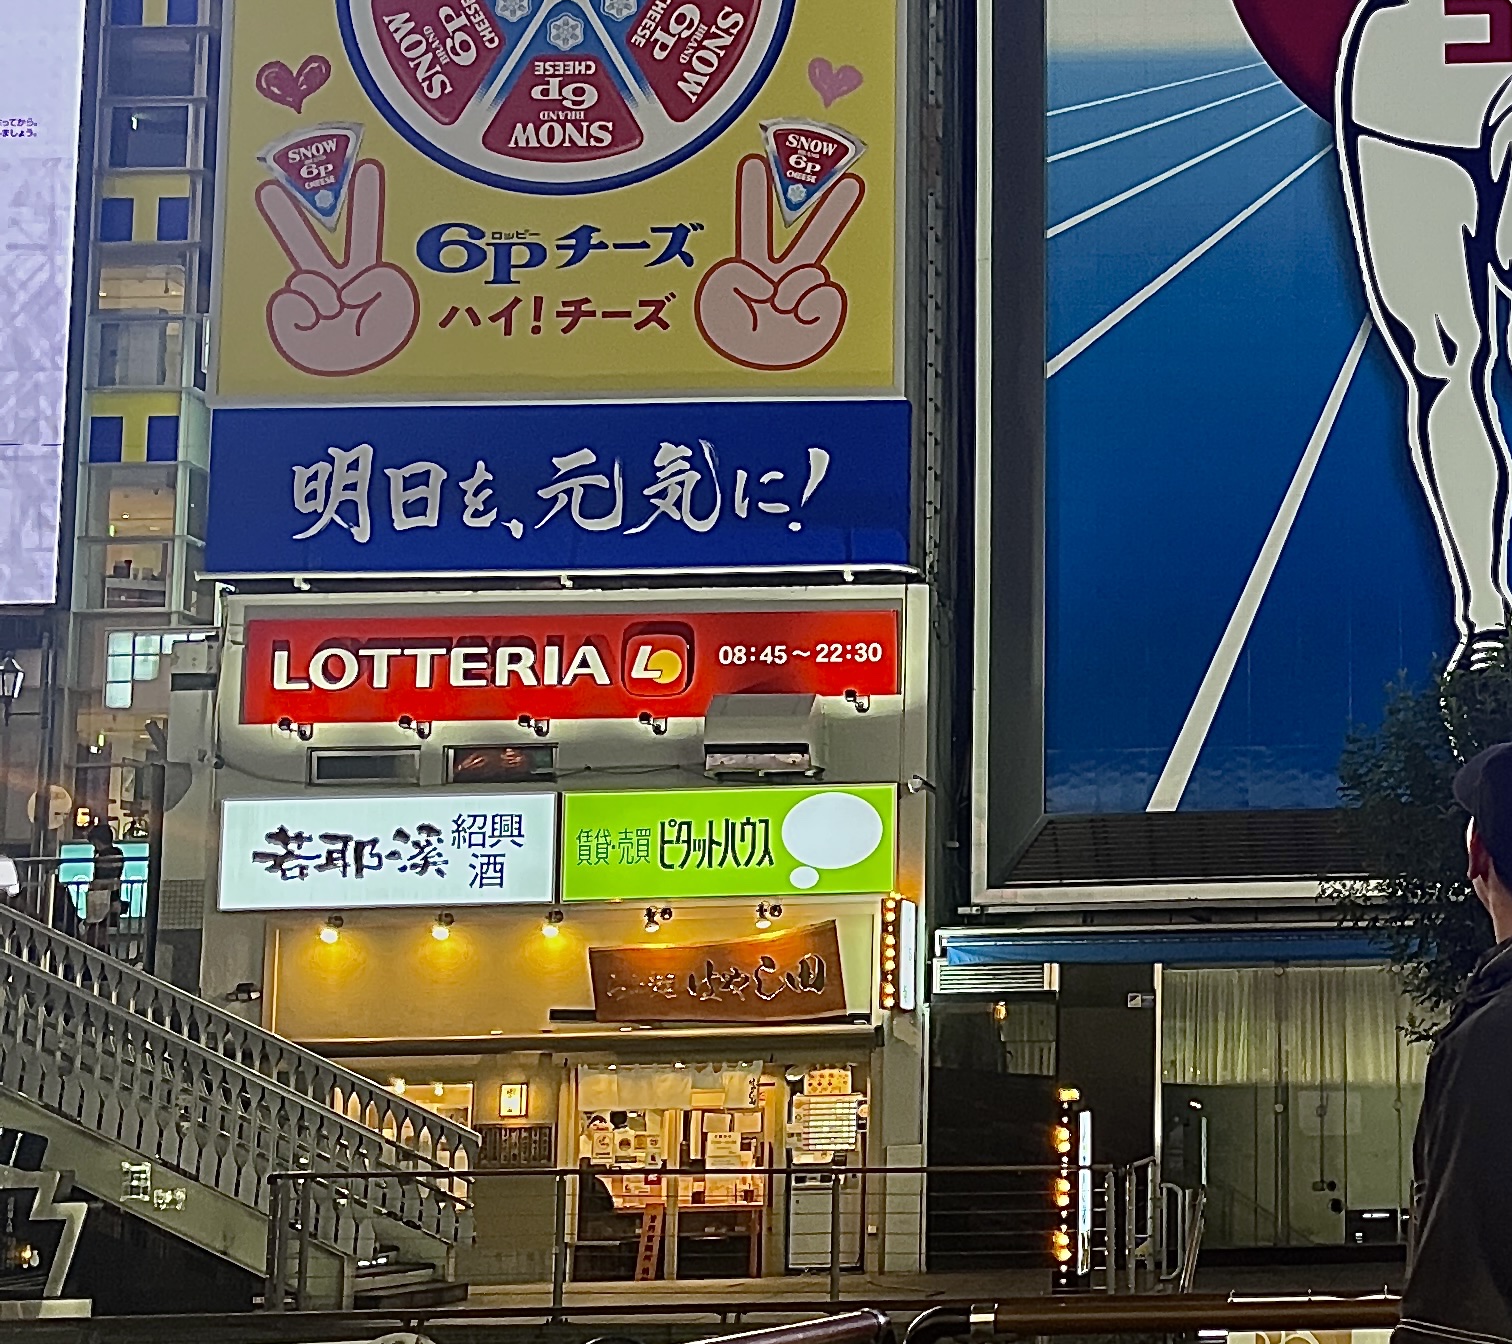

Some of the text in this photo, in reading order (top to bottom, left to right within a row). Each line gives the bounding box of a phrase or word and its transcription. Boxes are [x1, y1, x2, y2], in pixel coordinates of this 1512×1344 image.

[382, 11, 454, 100] SNOW
[423, 25, 450, 66] BRAND
[677, 6, 745, 104] SNOW
[534, 61, 596, 75] CHEESE
[508, 121, 613, 148] SNOW
[540, 111, 585, 120] BRAND
[288, 138, 337, 163] SNOW
[786, 134, 838, 156] SNOW
[292, 439, 830, 543] 明日を、元気に!
[272, 644, 611, 691] LOTTERIA
[659, 817, 775, 870] ピタットハウス
